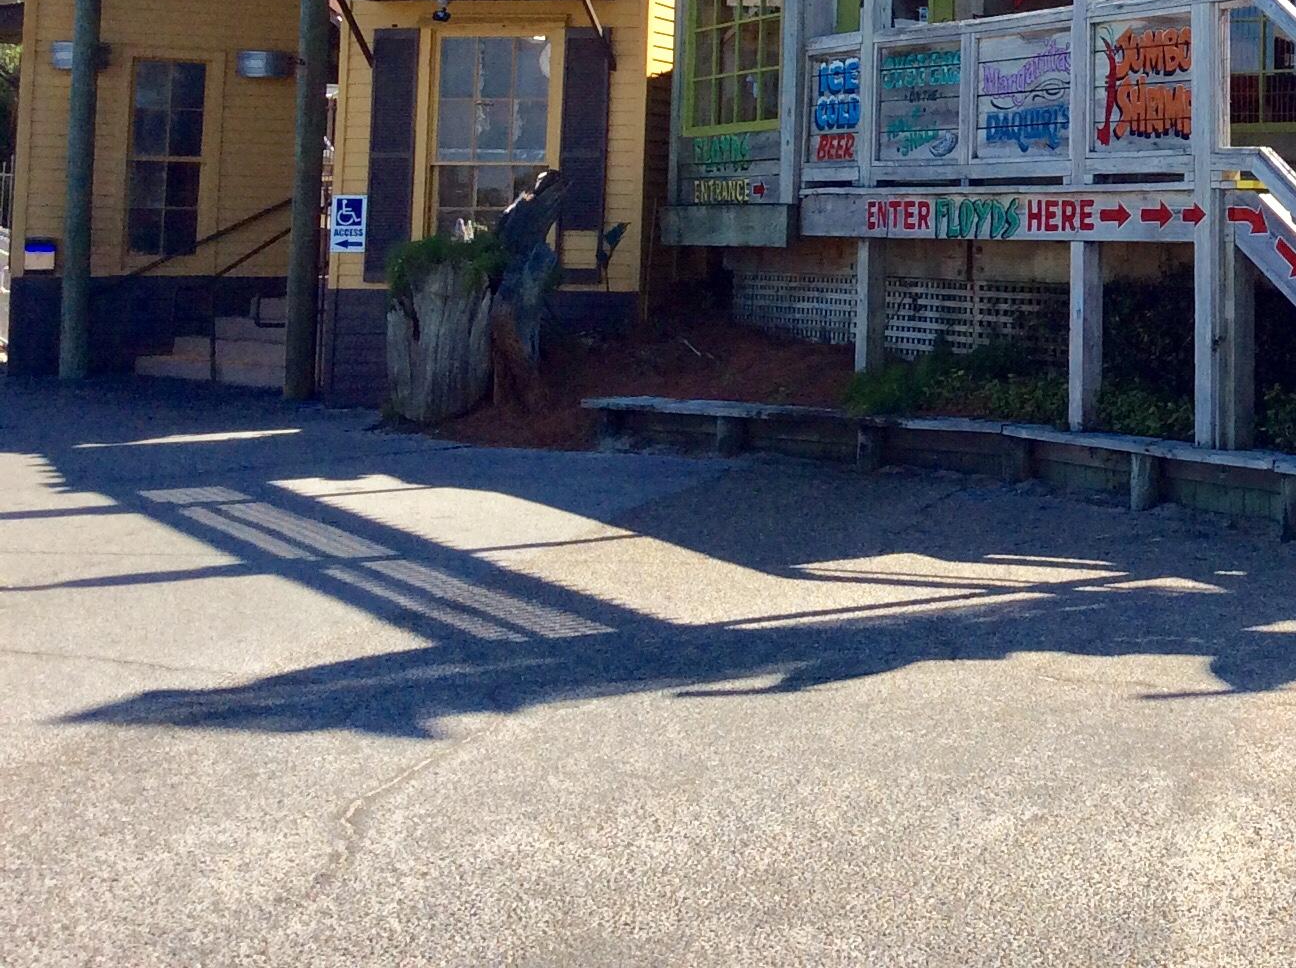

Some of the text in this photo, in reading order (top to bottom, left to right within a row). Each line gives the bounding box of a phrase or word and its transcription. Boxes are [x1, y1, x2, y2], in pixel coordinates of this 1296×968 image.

[818, 56, 861, 95] ICE
[815, 93, 861, 132] COLD
[816, 132, 856, 161] BEER
[334, 228, 364, 237] ACCESS
[866, 197, 1097, 239] ENTER FLOYDS HERE
